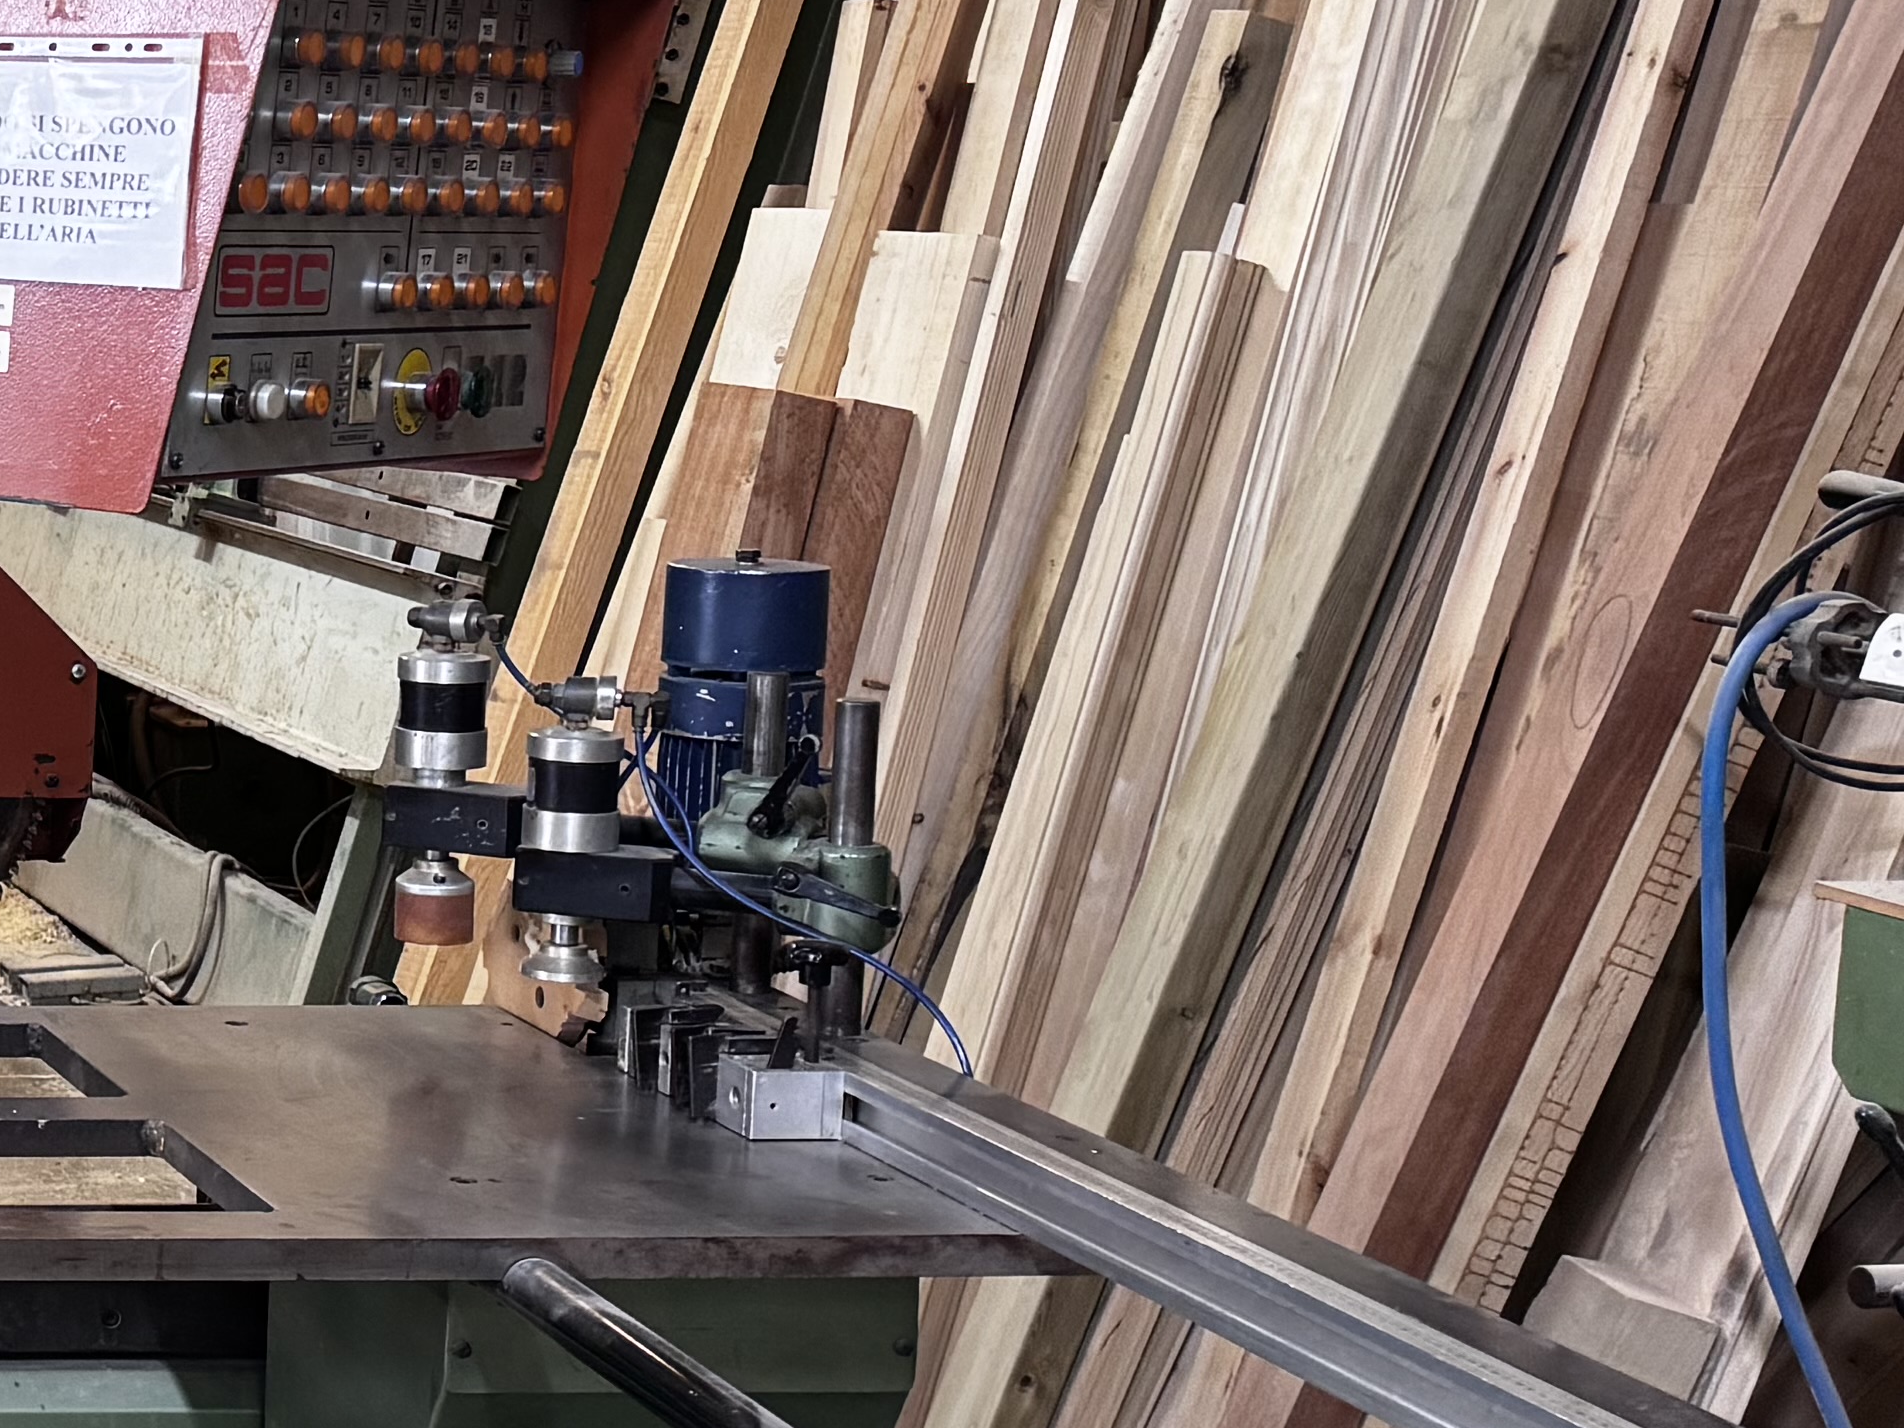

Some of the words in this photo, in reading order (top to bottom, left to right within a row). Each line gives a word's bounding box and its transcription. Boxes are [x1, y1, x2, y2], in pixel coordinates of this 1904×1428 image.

[284, 79, 292, 92] 2
[402, 87, 412, 99] 11
[2, 141, 127, 163] ACCHINE
[276, 152, 284, 164] 3
[318, 153, 325, 165] 6
[464, 159, 477, 172] 20
[60, 170, 150, 192] SEMPRE
[18, 195, 25, 214] I
[32, 197, 152, 220] RUBINETTI
[421, 254, 433, 266] 17
[456, 253, 468, 265] 21
